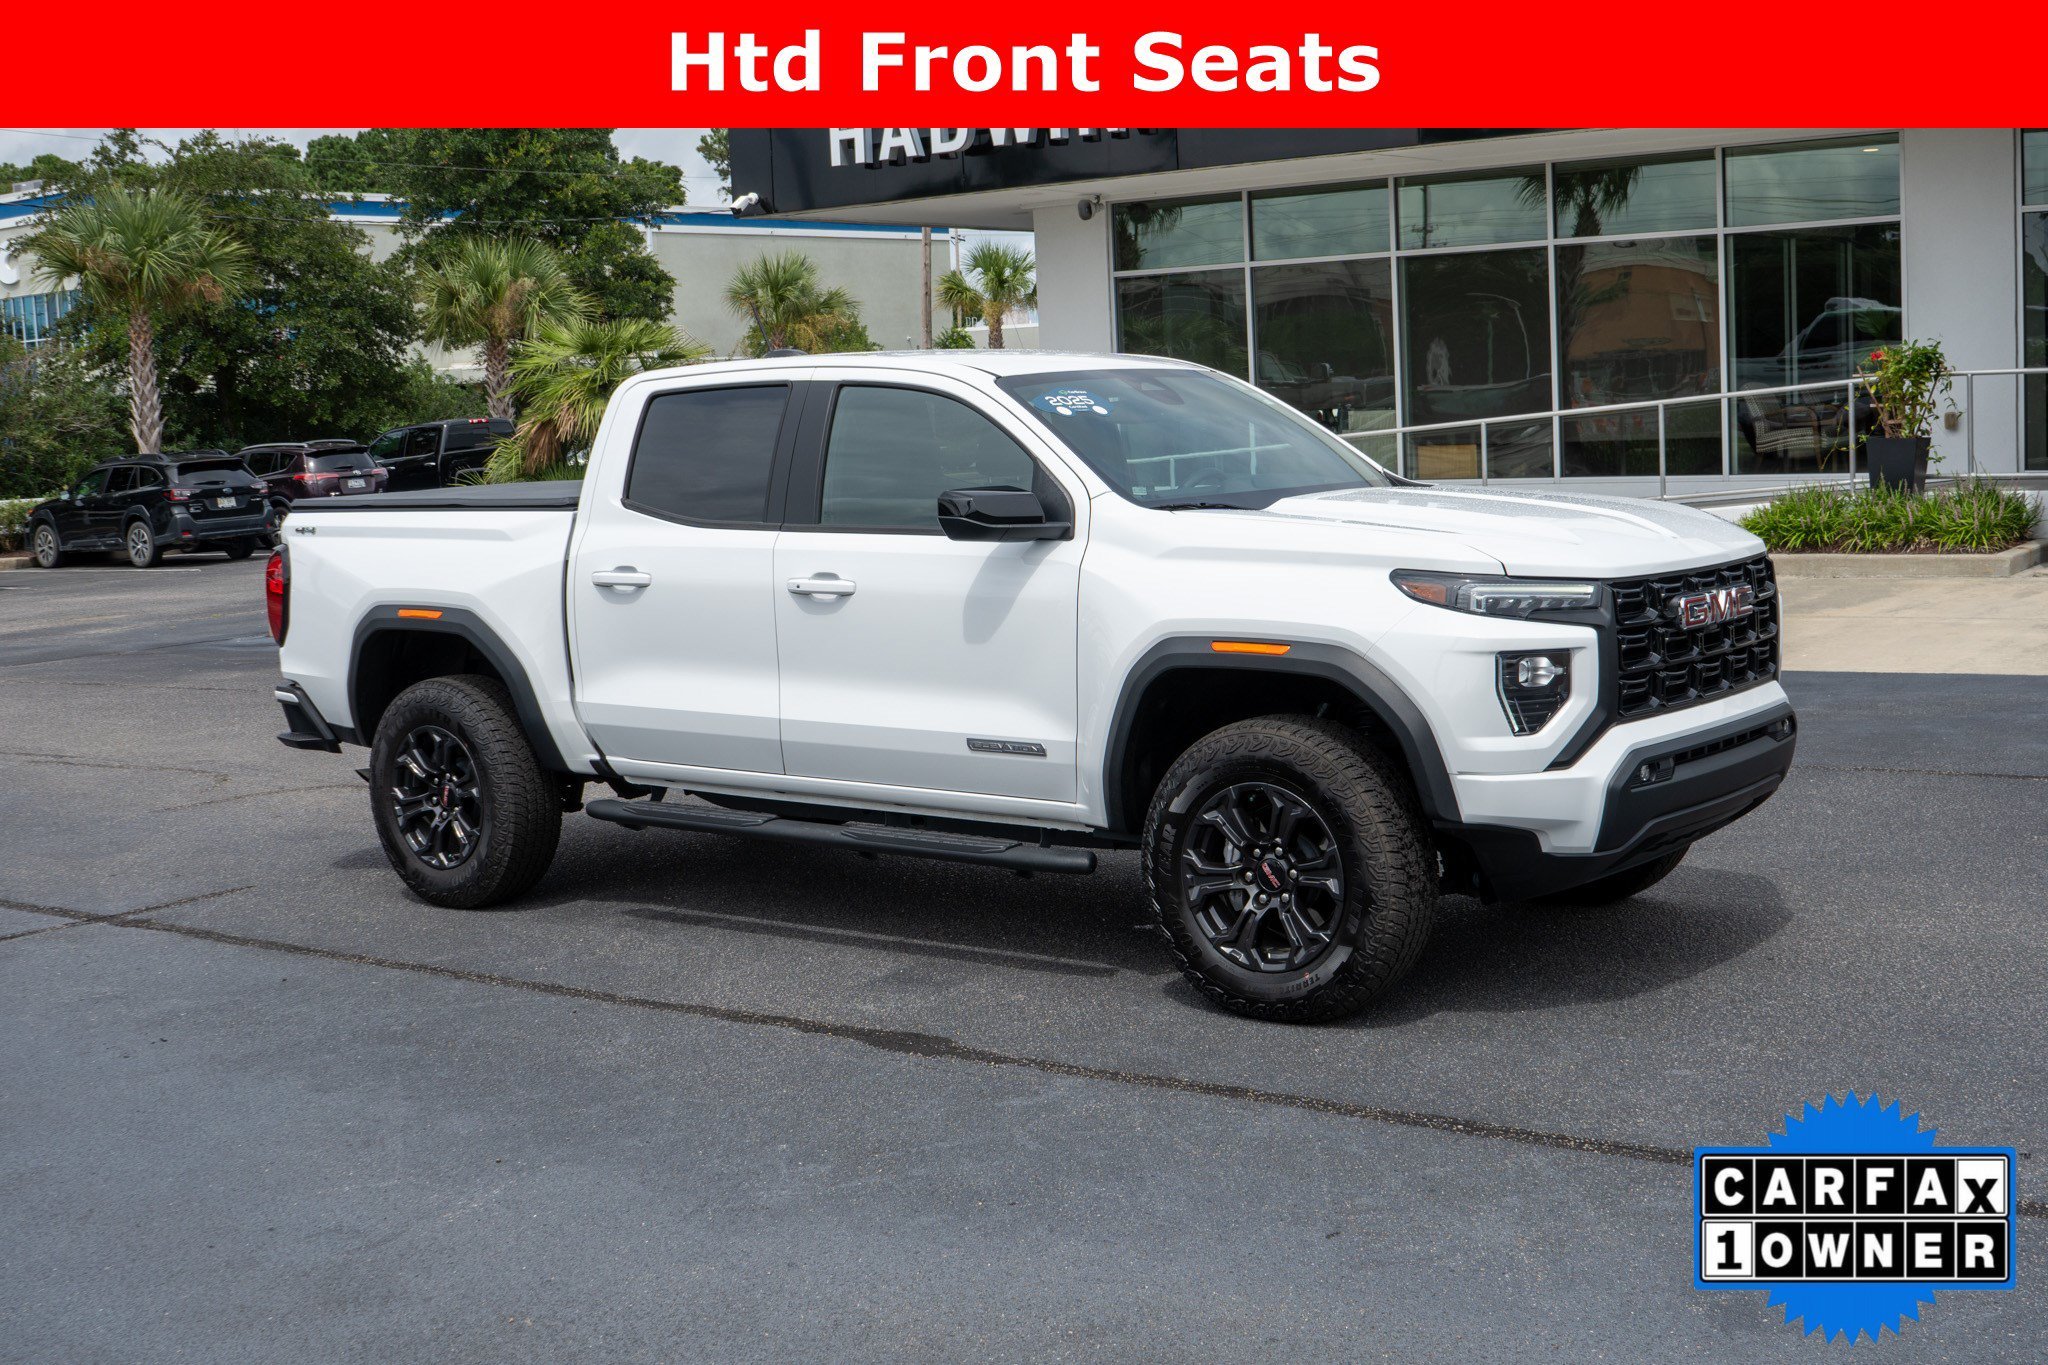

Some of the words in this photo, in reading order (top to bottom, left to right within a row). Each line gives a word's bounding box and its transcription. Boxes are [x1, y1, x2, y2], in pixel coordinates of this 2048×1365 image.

[830, 128, 1127, 167] HAD
[1045, 396, 1094, 405] 2025
[1679, 585, 1753, 630] GMC
